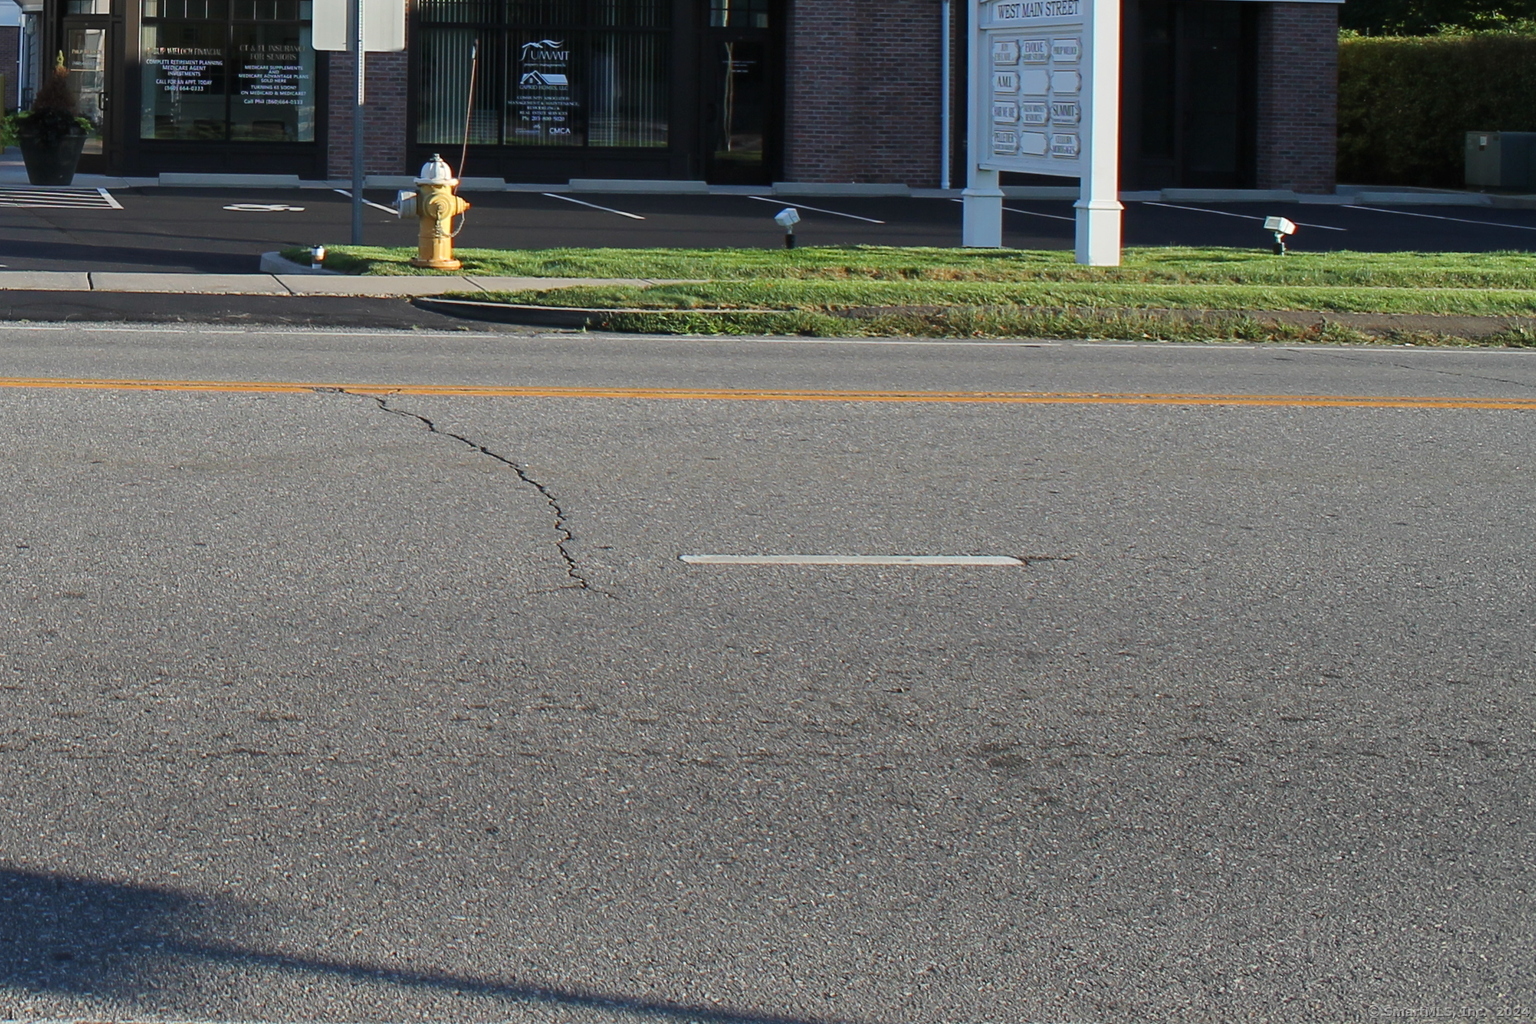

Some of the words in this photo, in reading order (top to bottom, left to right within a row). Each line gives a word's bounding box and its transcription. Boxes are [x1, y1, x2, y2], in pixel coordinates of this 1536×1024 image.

[998, 3, 1020, 19] WEST
[1022, 1, 1043, 18] MAIN
[1046, 0, 1079, 16] STREET
[1025, 42, 1044, 53] EVOLVE
[1053, 105, 1074, 116] SUMMIT
